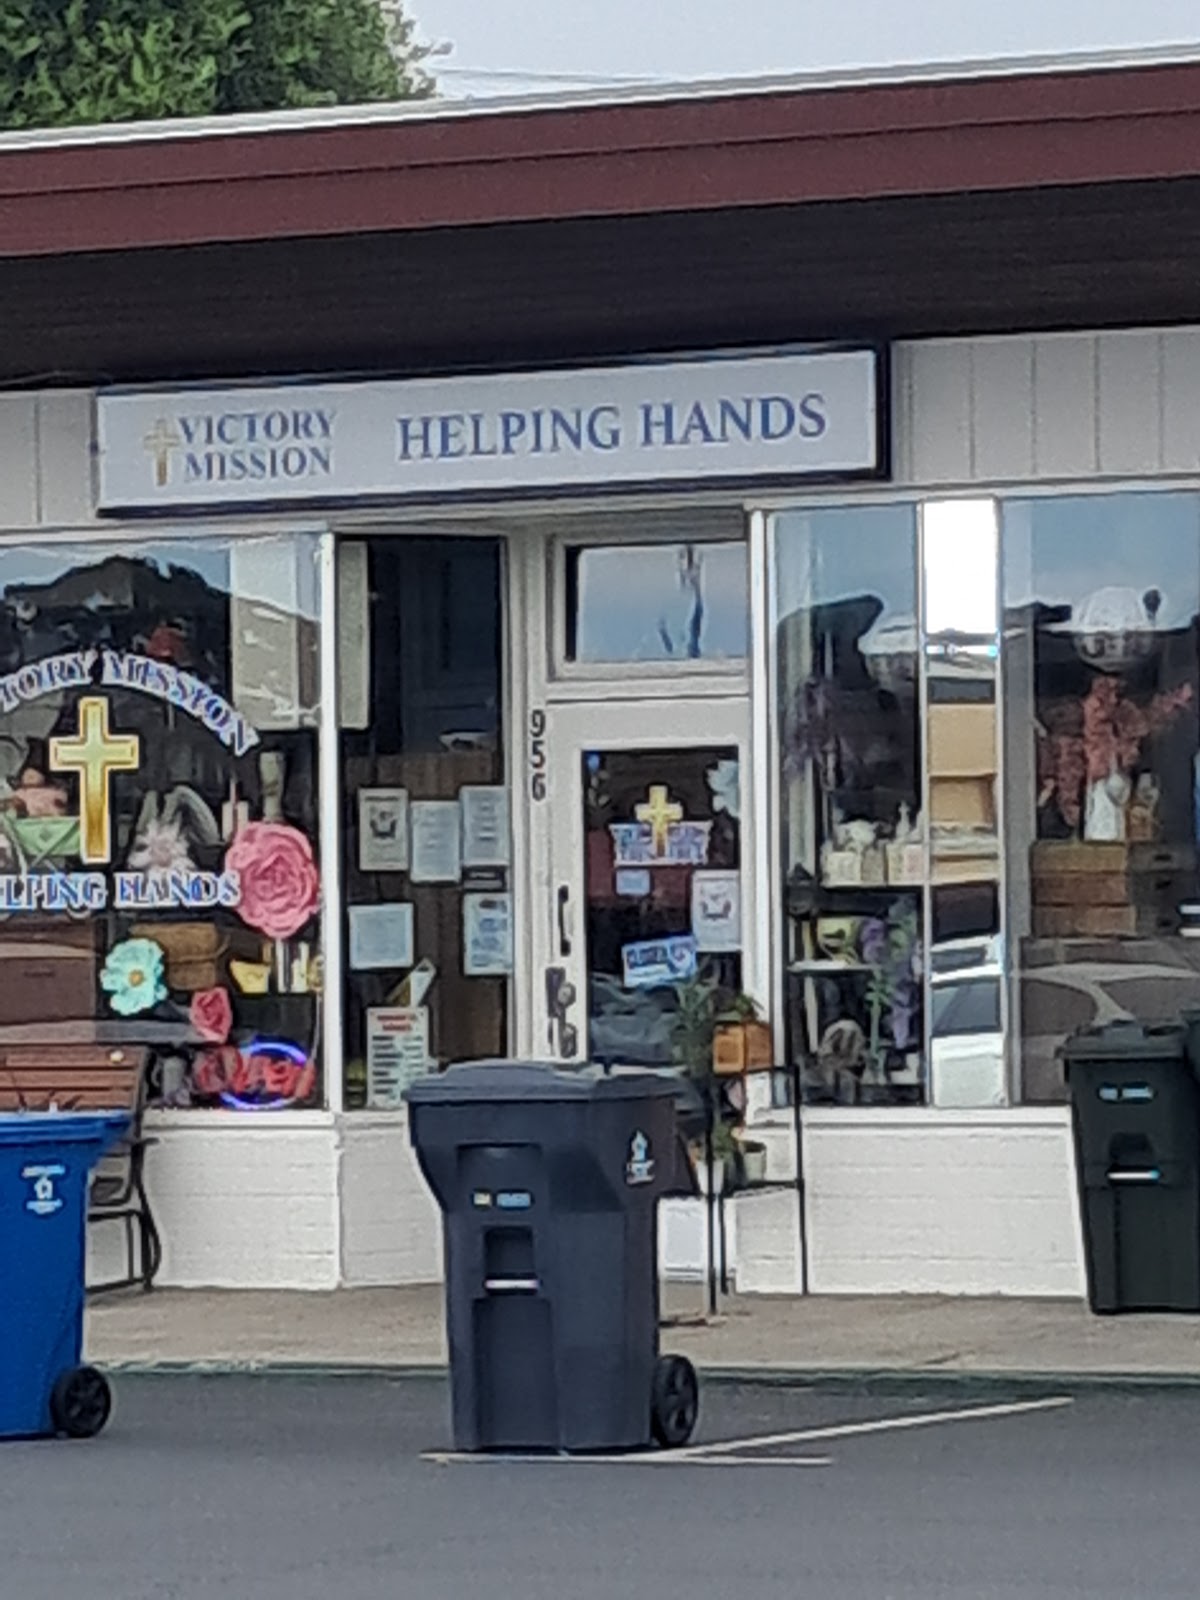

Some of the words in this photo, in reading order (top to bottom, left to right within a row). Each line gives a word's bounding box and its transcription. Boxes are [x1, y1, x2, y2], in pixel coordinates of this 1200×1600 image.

[179, 409, 337, 445] VICTORY
[397, 404, 621, 461] HELPING
[640, 392, 828, 447] HANDS
[184, 446, 331, 483] MISSION
[101, 652, 259, 756] MISSION
[530, 709, 546, 801] 956
[0, 872, 107, 910] LPING
[114, 869, 241, 908] HANDS
